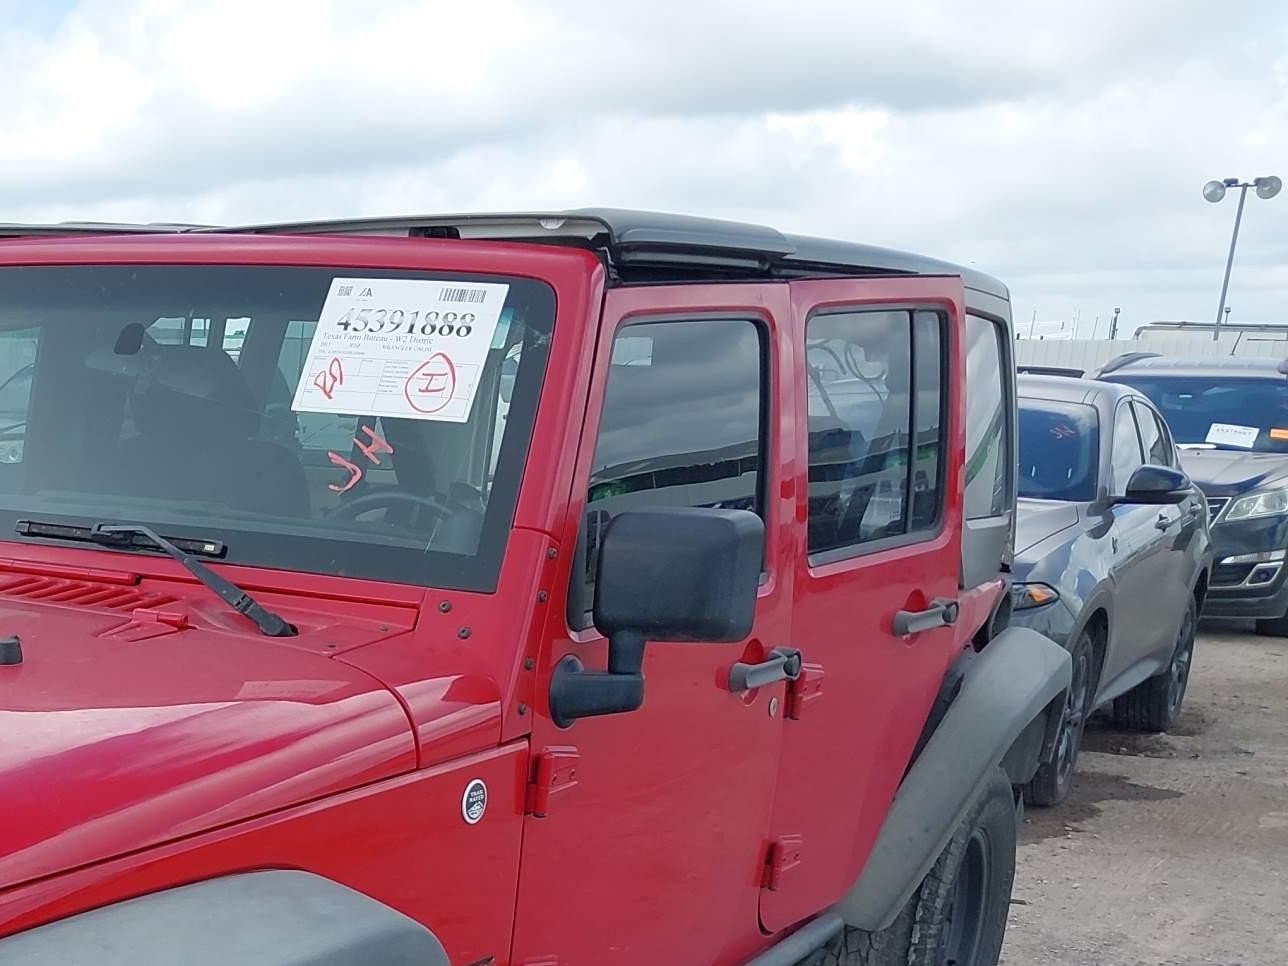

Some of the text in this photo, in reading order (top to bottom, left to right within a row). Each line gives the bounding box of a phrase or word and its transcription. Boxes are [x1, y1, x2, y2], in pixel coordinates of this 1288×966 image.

[337, 307, 476, 338] 45391888
[322, 332, 343, 341] Texas
[343, 333, 362, 341] Farm
[363, 333, 389, 343] Bureau
[395, 335, 408, 343] W2
